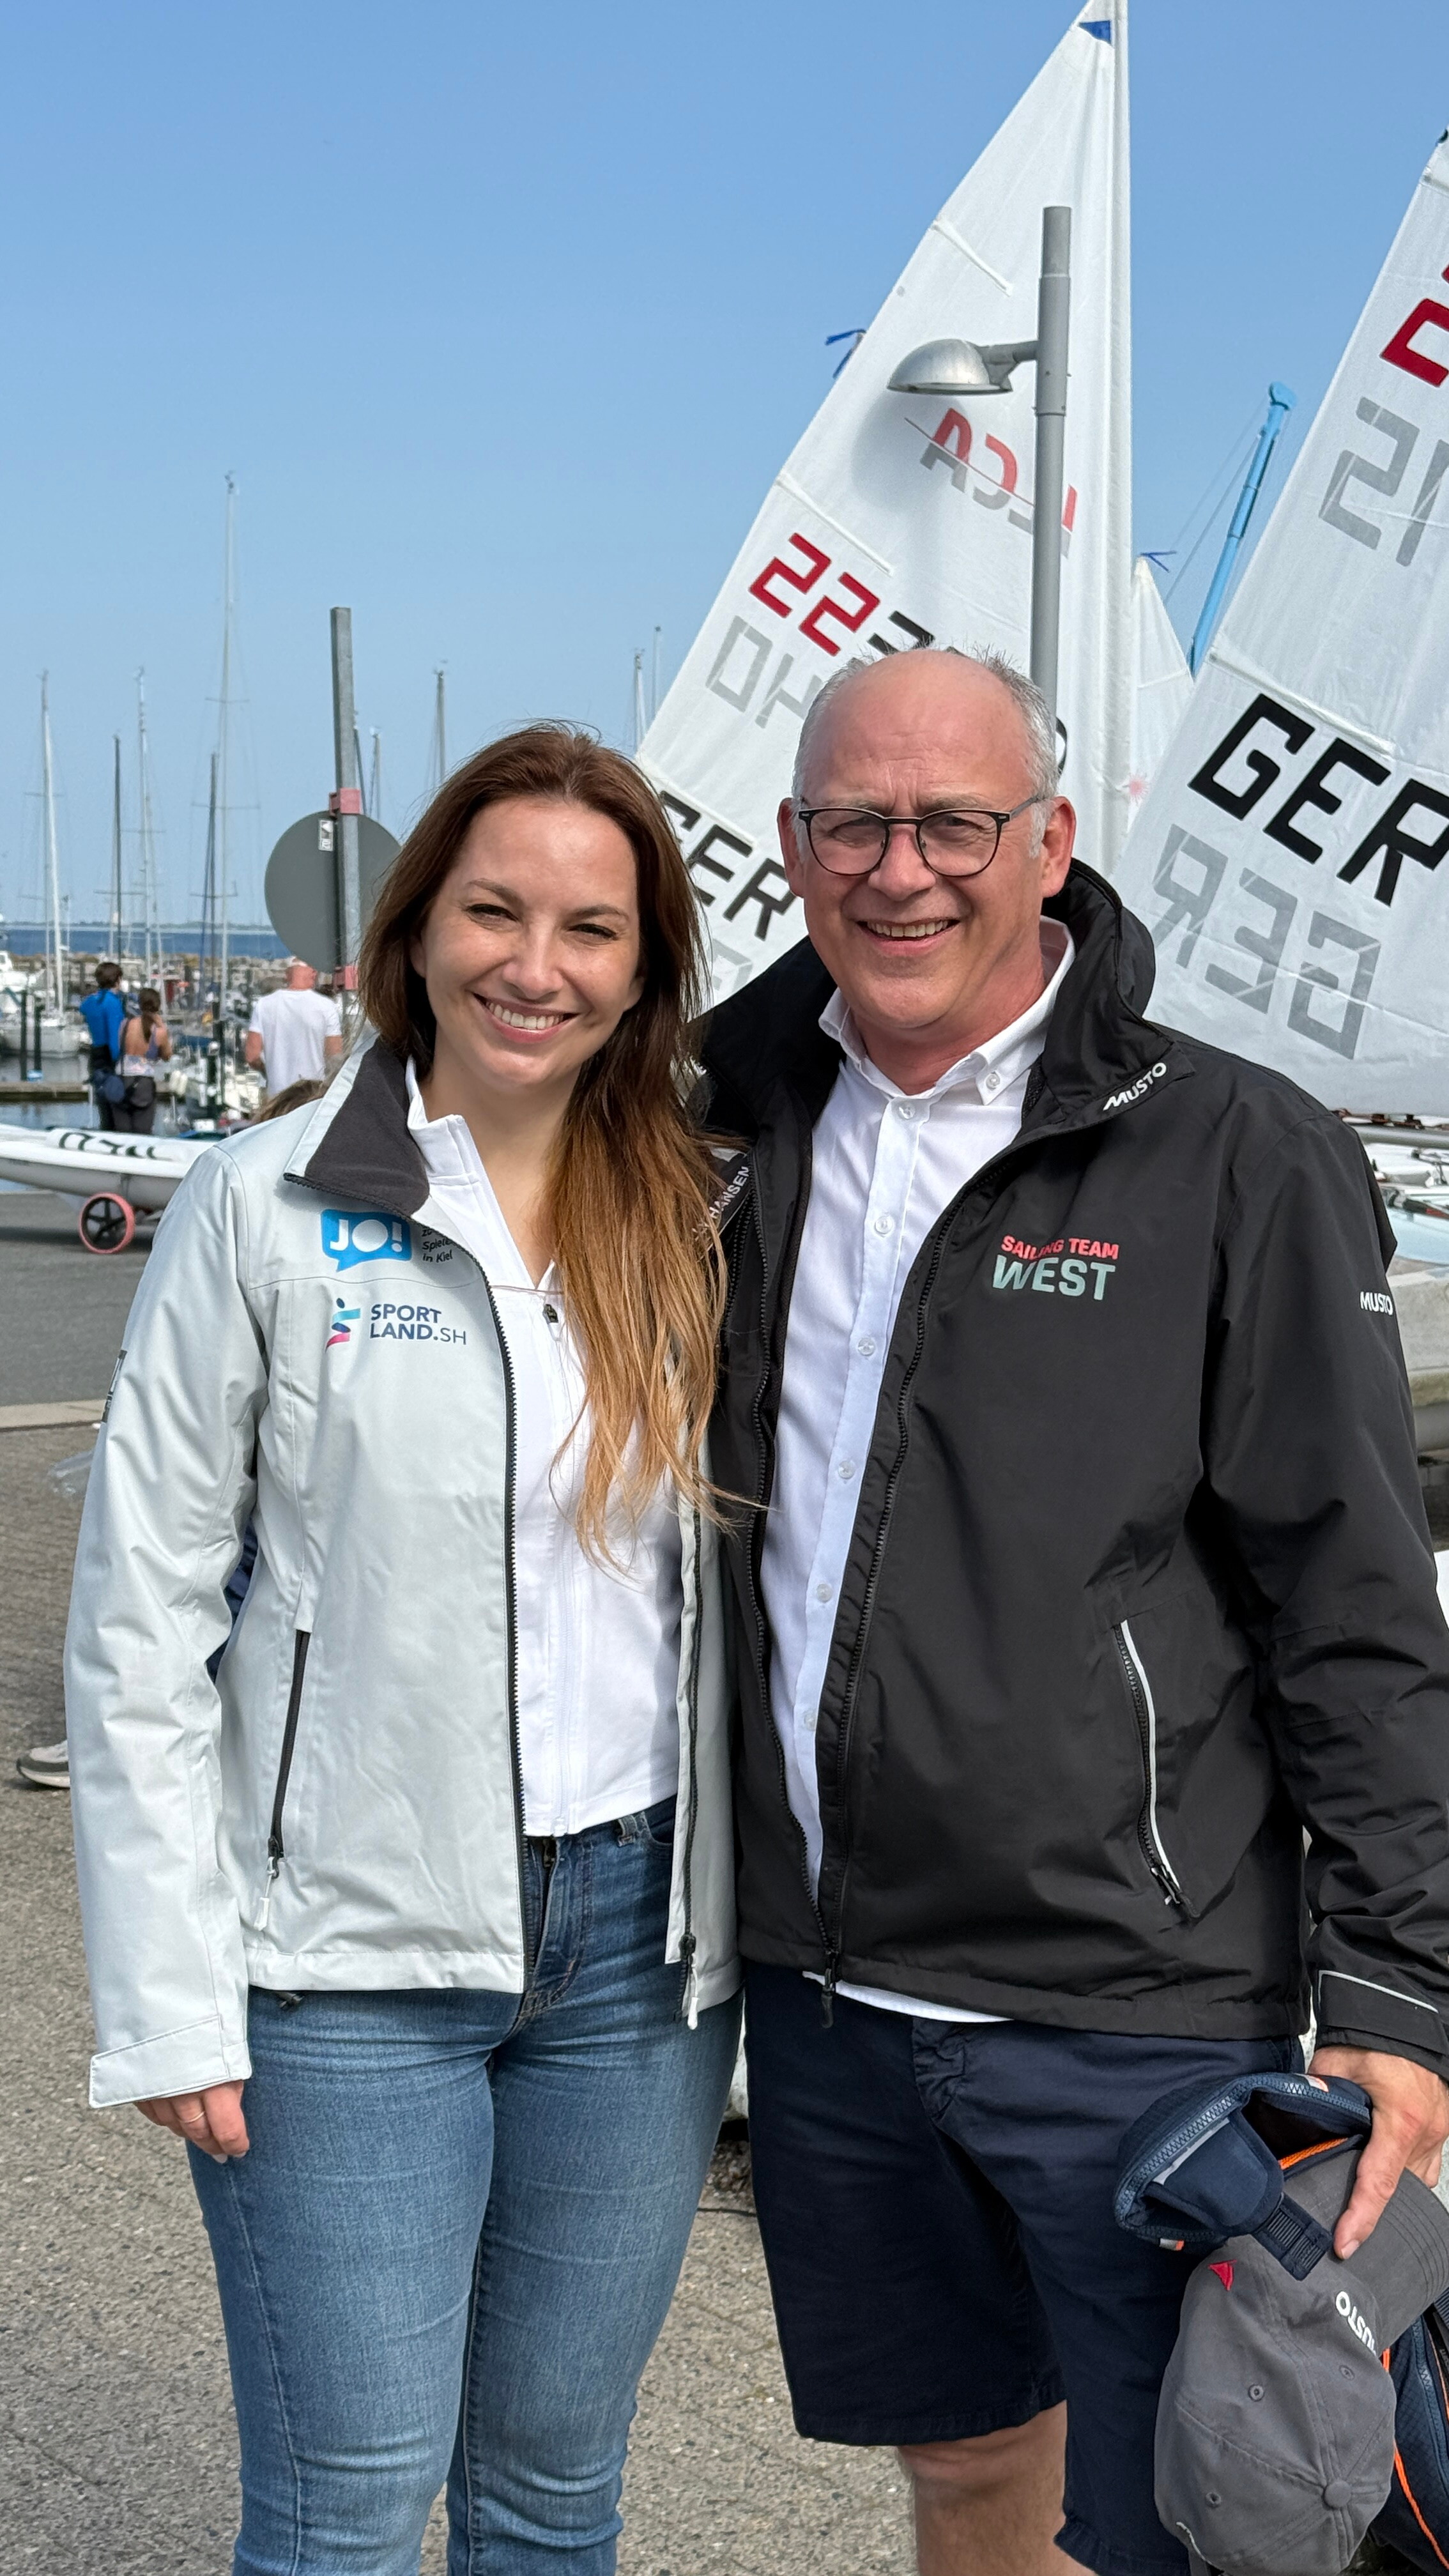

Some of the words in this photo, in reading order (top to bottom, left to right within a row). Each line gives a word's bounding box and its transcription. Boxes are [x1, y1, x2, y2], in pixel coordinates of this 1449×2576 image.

[1188, 693, 1449, 907] GER
[1103, 1062, 1167, 1111] MUSTO
[709, 1165, 751, 1219] HANSEN
[330, 1219, 402, 1253] JO!
[1001, 1234, 1064, 1261] SAILING
[1069, 1238, 1119, 1260] TEAM
[436, 1249, 453, 1263] Kiel
[992, 1254, 1116, 1301] WEST
[371, 1304, 441, 1324] SPORT
[1360, 1291, 1393, 1315] MUSTO
[369, 1322, 466, 1346] LAND.SH
